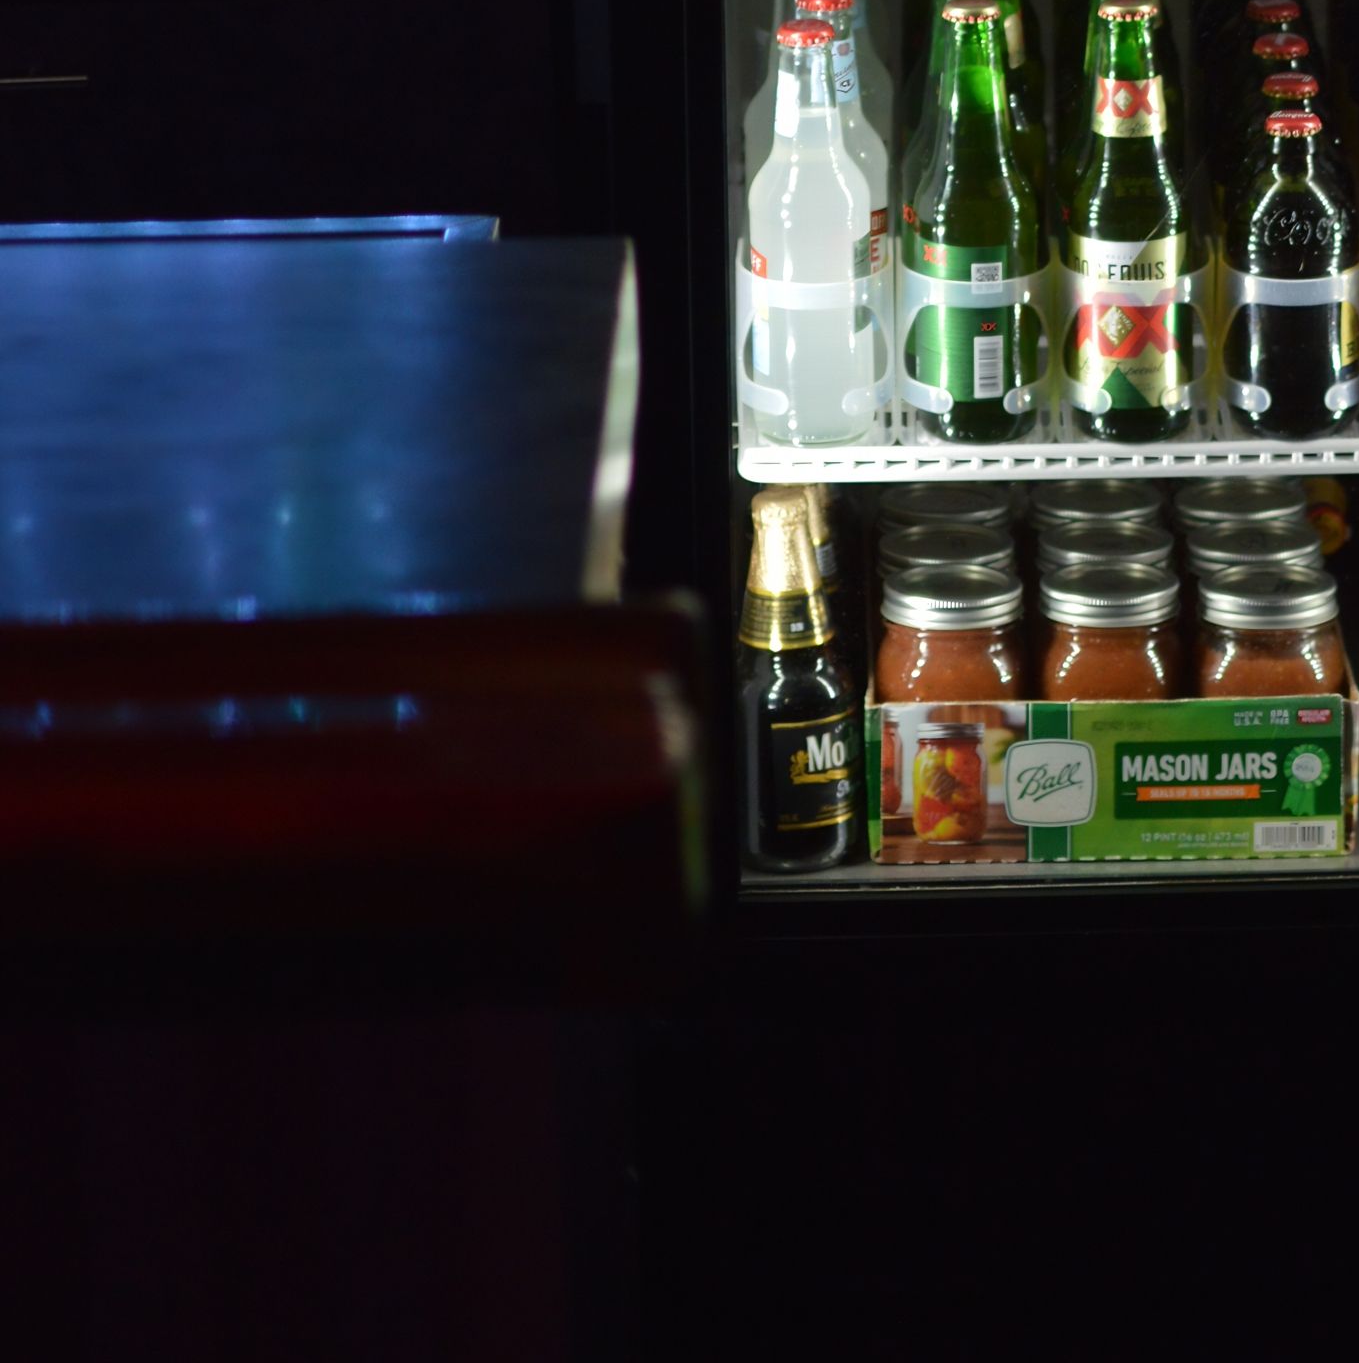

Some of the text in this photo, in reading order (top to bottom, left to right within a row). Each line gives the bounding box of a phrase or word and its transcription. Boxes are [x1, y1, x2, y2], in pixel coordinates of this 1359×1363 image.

[1016, 761, 1083, 801] Ball
[1121, 751, 1278, 783] MASON JARS
